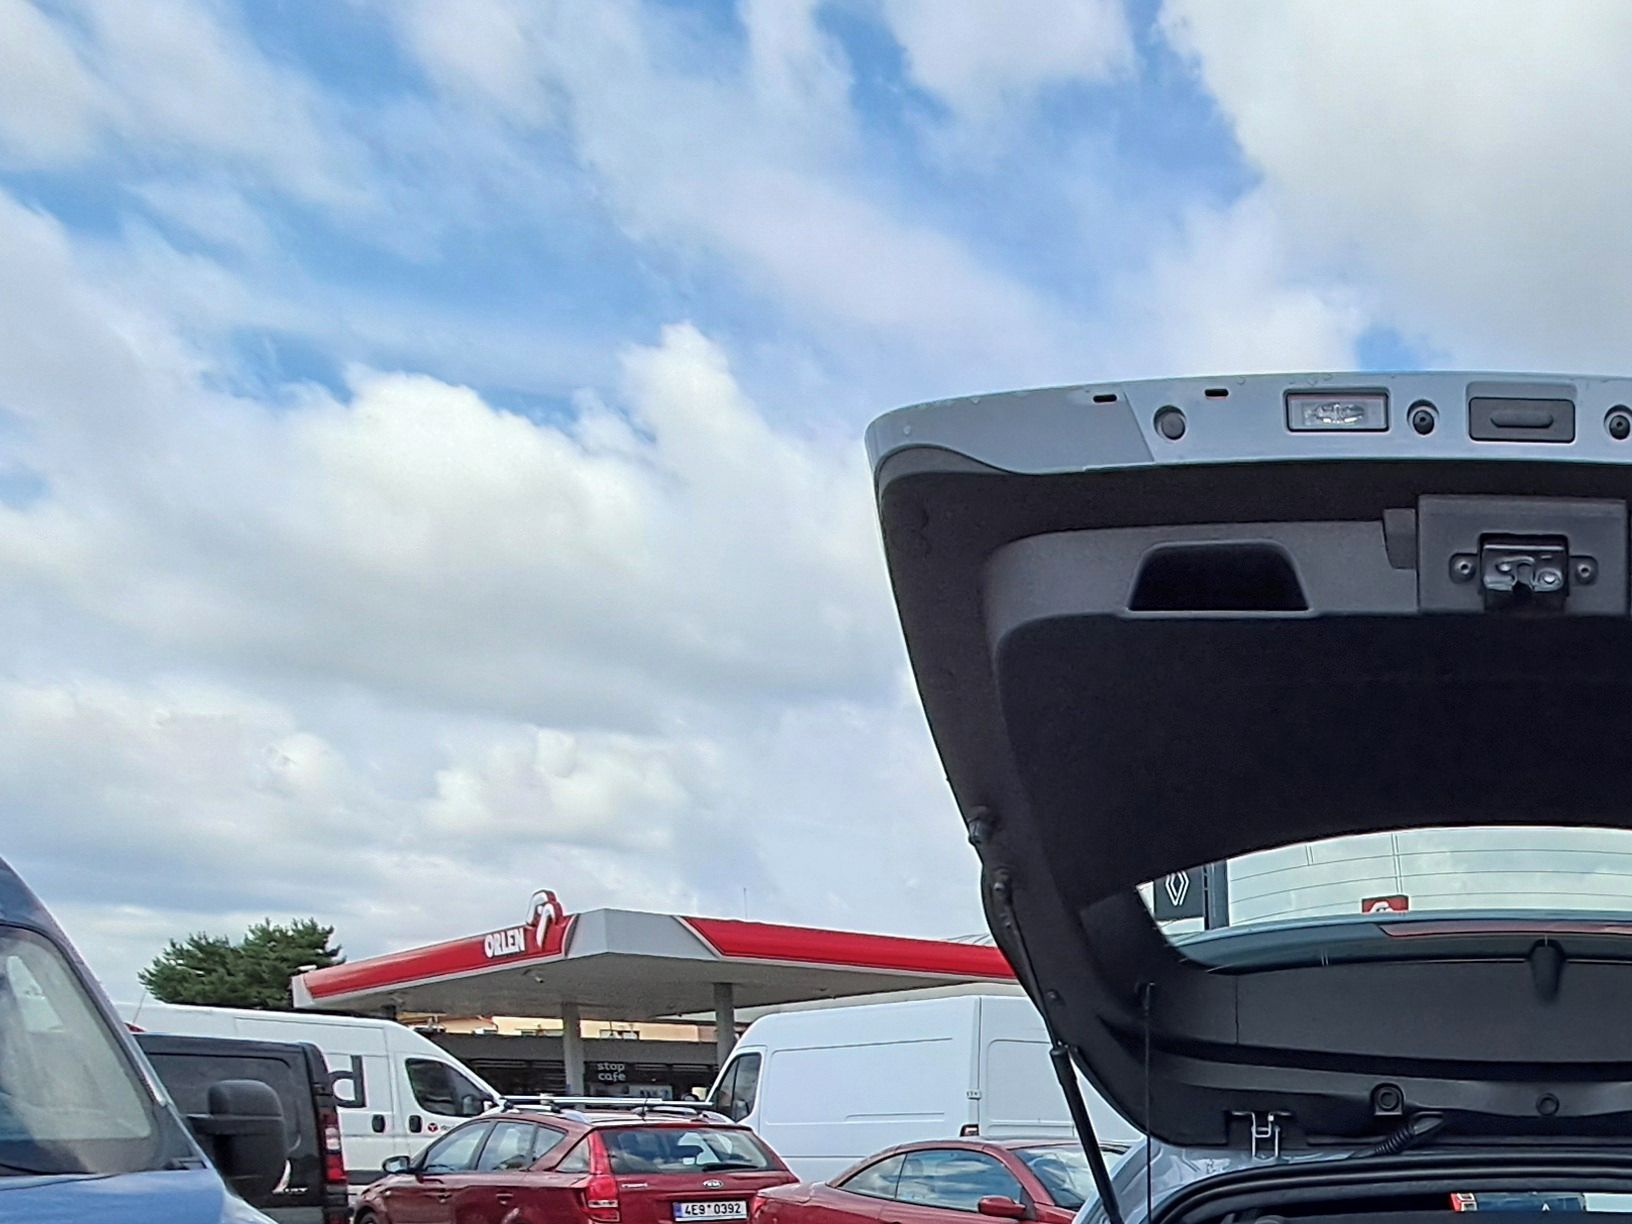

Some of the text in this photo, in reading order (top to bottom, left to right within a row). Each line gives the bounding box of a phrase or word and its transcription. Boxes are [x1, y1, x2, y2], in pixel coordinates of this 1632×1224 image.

[484, 927, 526, 958] ORLEN
[597, 1063, 625, 1072] stop
[598, 1072, 626, 1081] cafe
[684, 1202, 742, 1216] 4E9 0392
